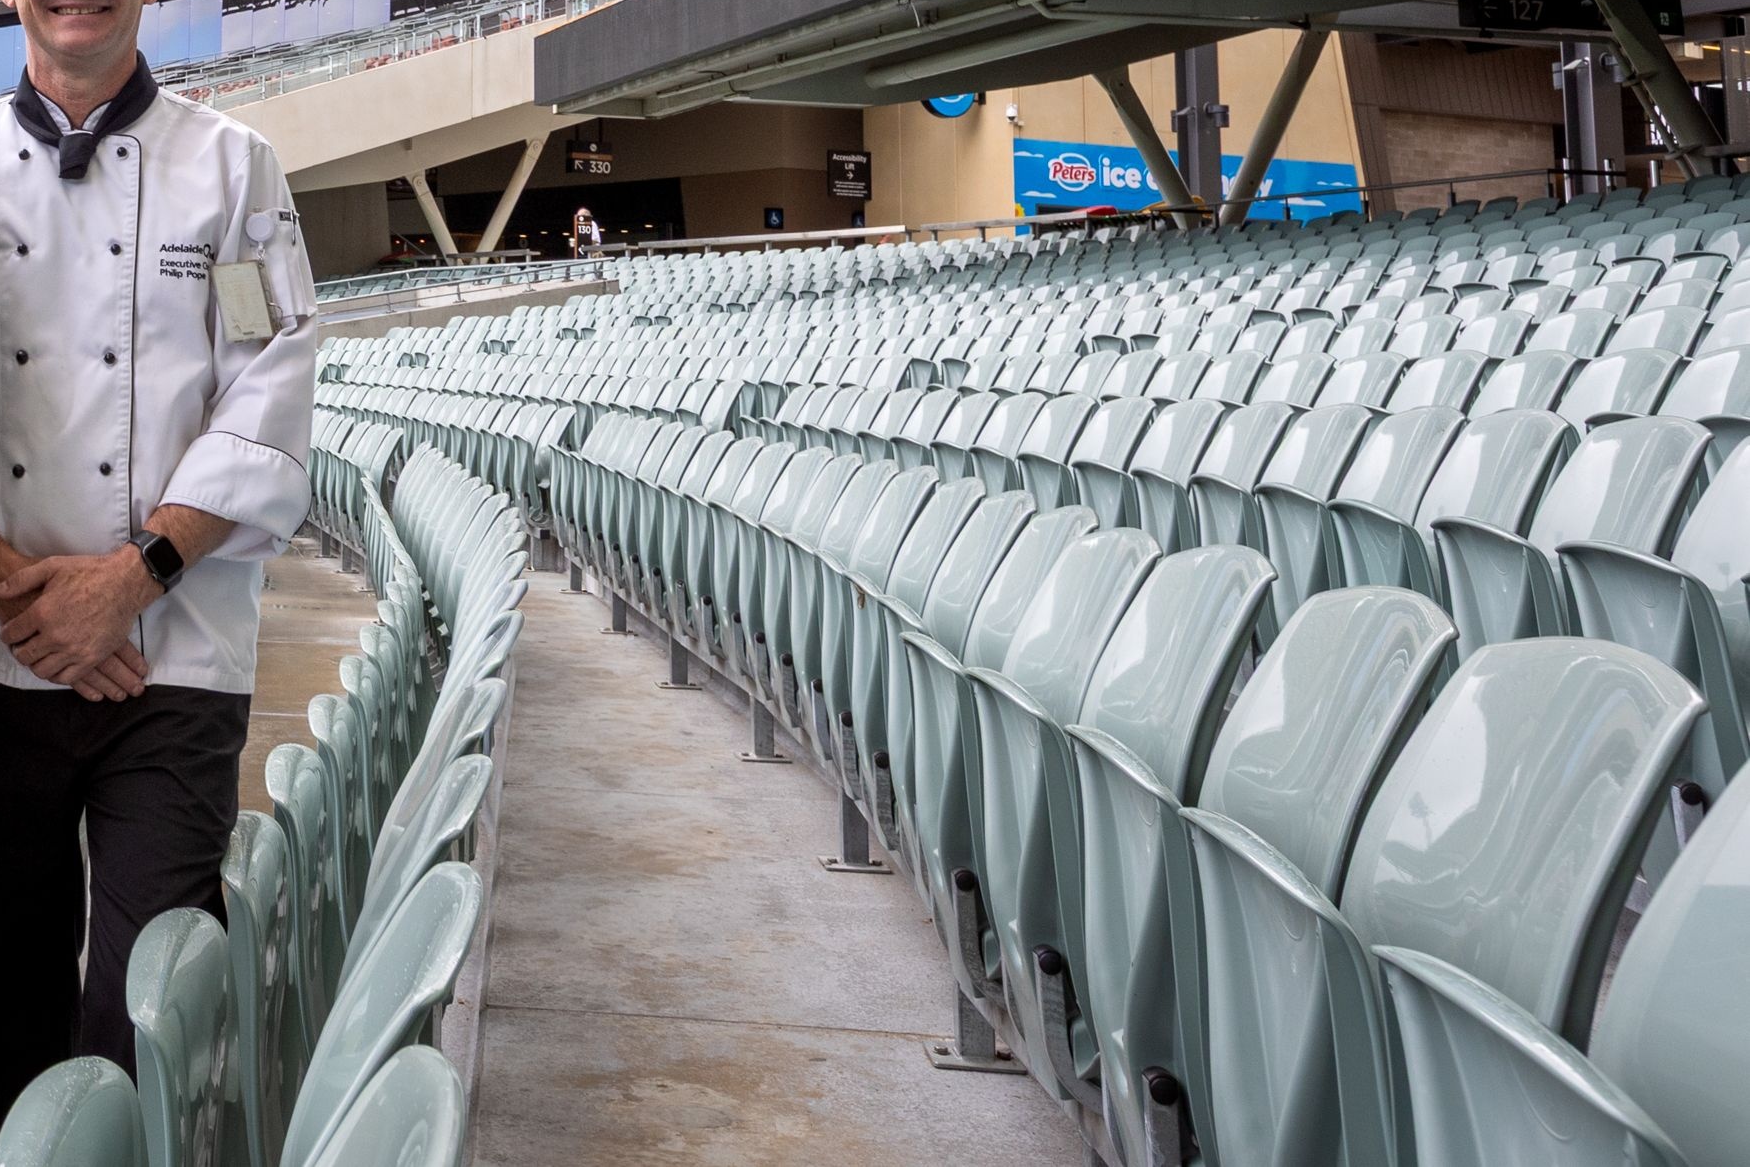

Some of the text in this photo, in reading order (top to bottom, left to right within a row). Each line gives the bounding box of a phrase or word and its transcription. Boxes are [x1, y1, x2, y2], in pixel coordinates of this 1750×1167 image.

[1509, 0, 1544, 21] 127
[832, 153, 867, 163] Accessibility
[589, 160, 611, 174] 330
[1052, 161, 1095, 183] Peters
[1102, 157, 1142, 189] ice
[578, 225, 591, 234] 130
[159, 243, 204, 254] Adelaide
[159, 259, 201, 269] Executive
[159, 269, 207, 280] Philip Pope
